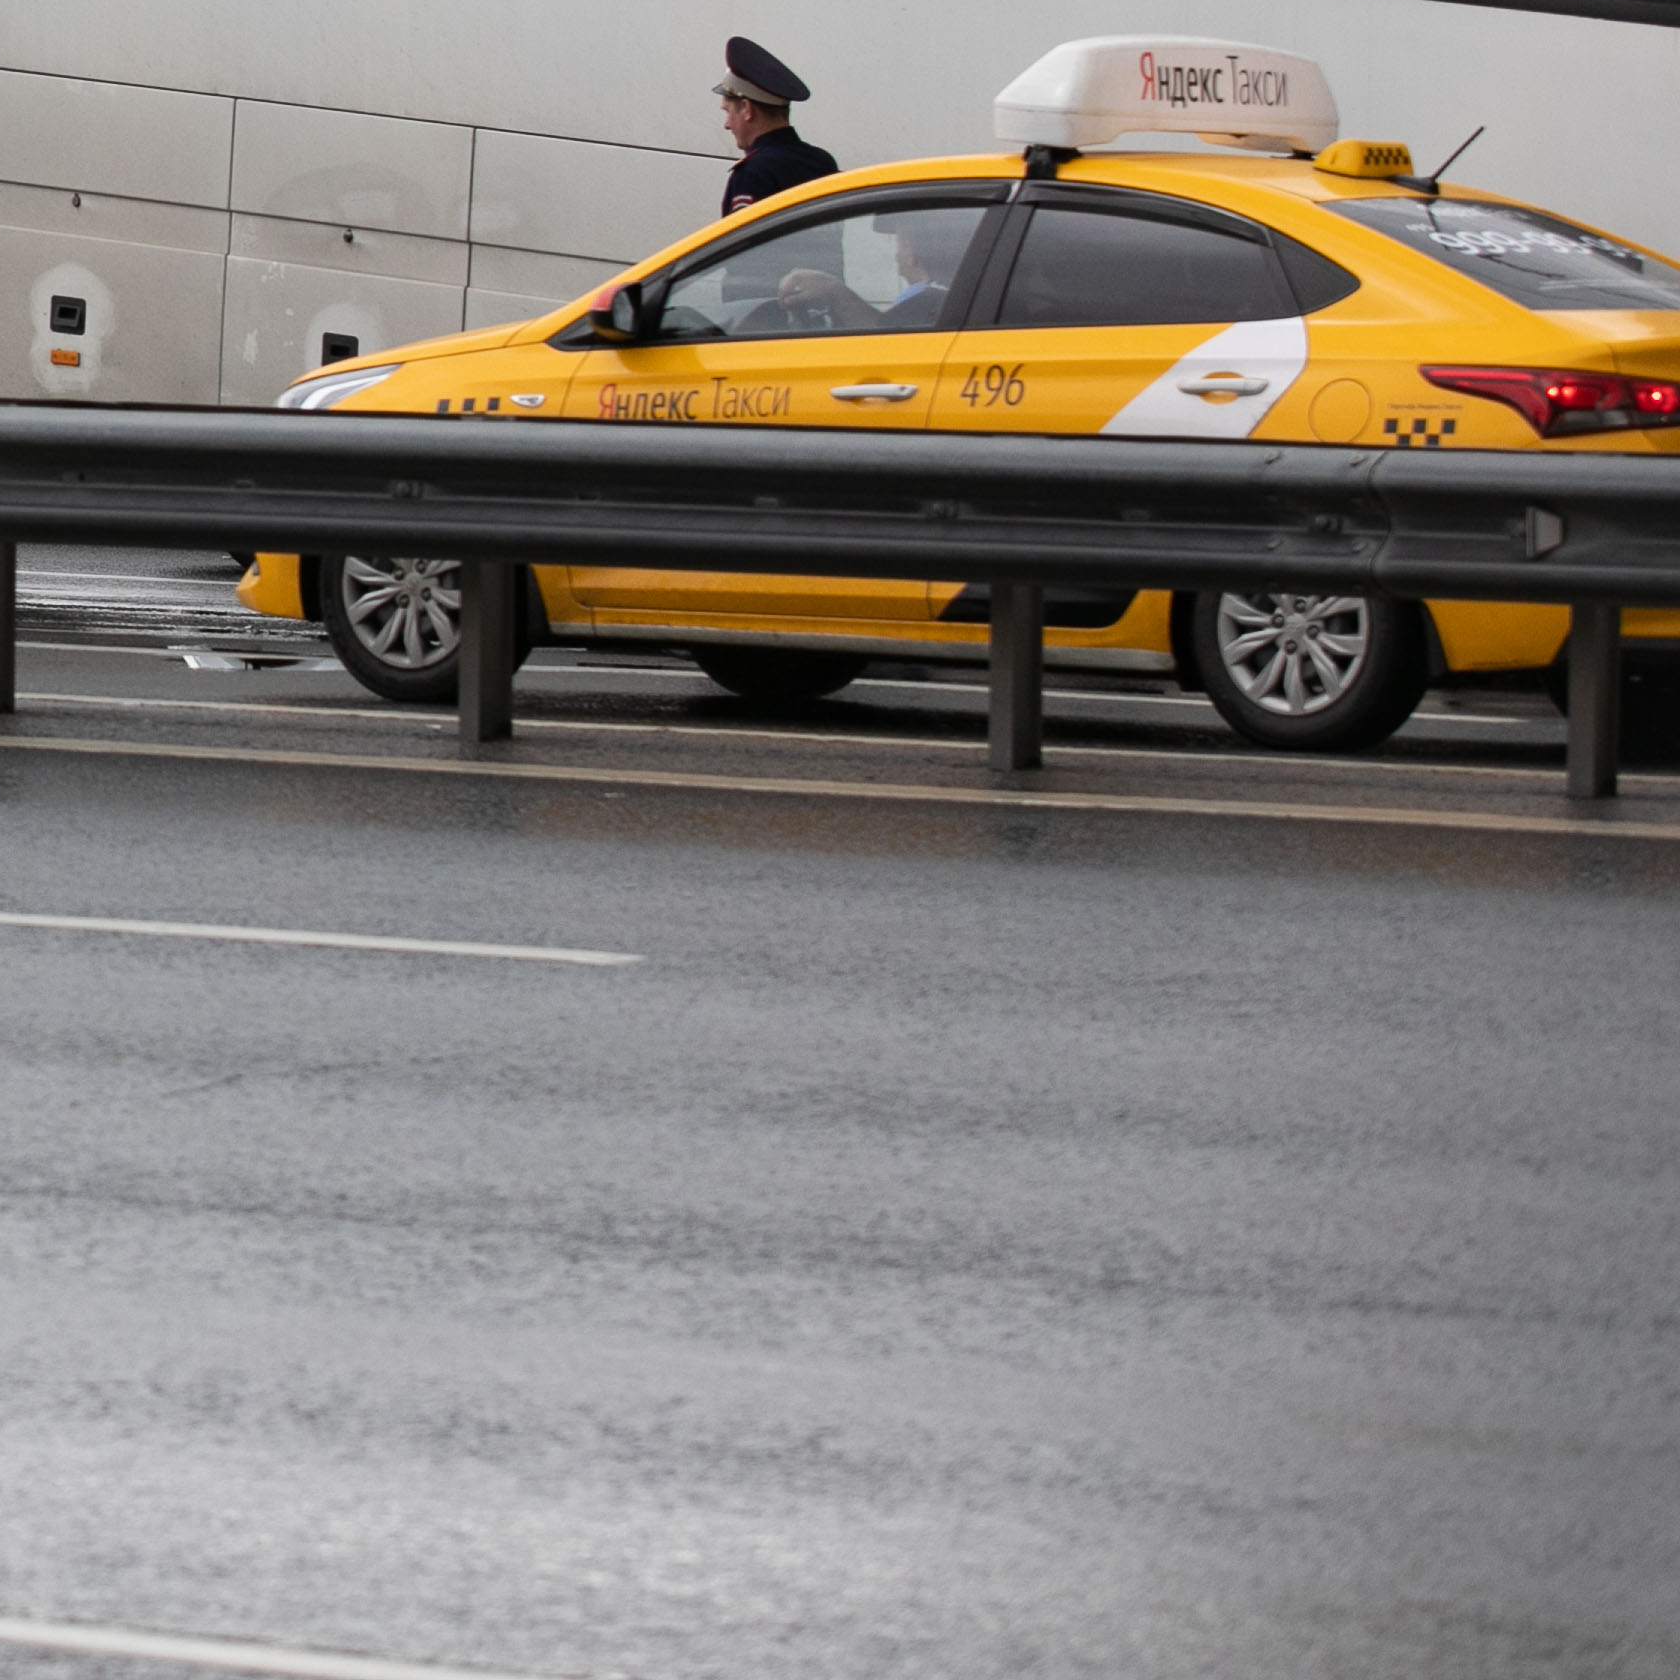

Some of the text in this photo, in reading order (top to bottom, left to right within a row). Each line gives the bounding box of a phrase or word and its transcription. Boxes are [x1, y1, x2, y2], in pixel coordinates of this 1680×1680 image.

[1139, 51, 1290, 108] Яндекс Такси
[598, 376, 792, 421] Яндекс Такси
[960, 363, 1026, 408] 496
